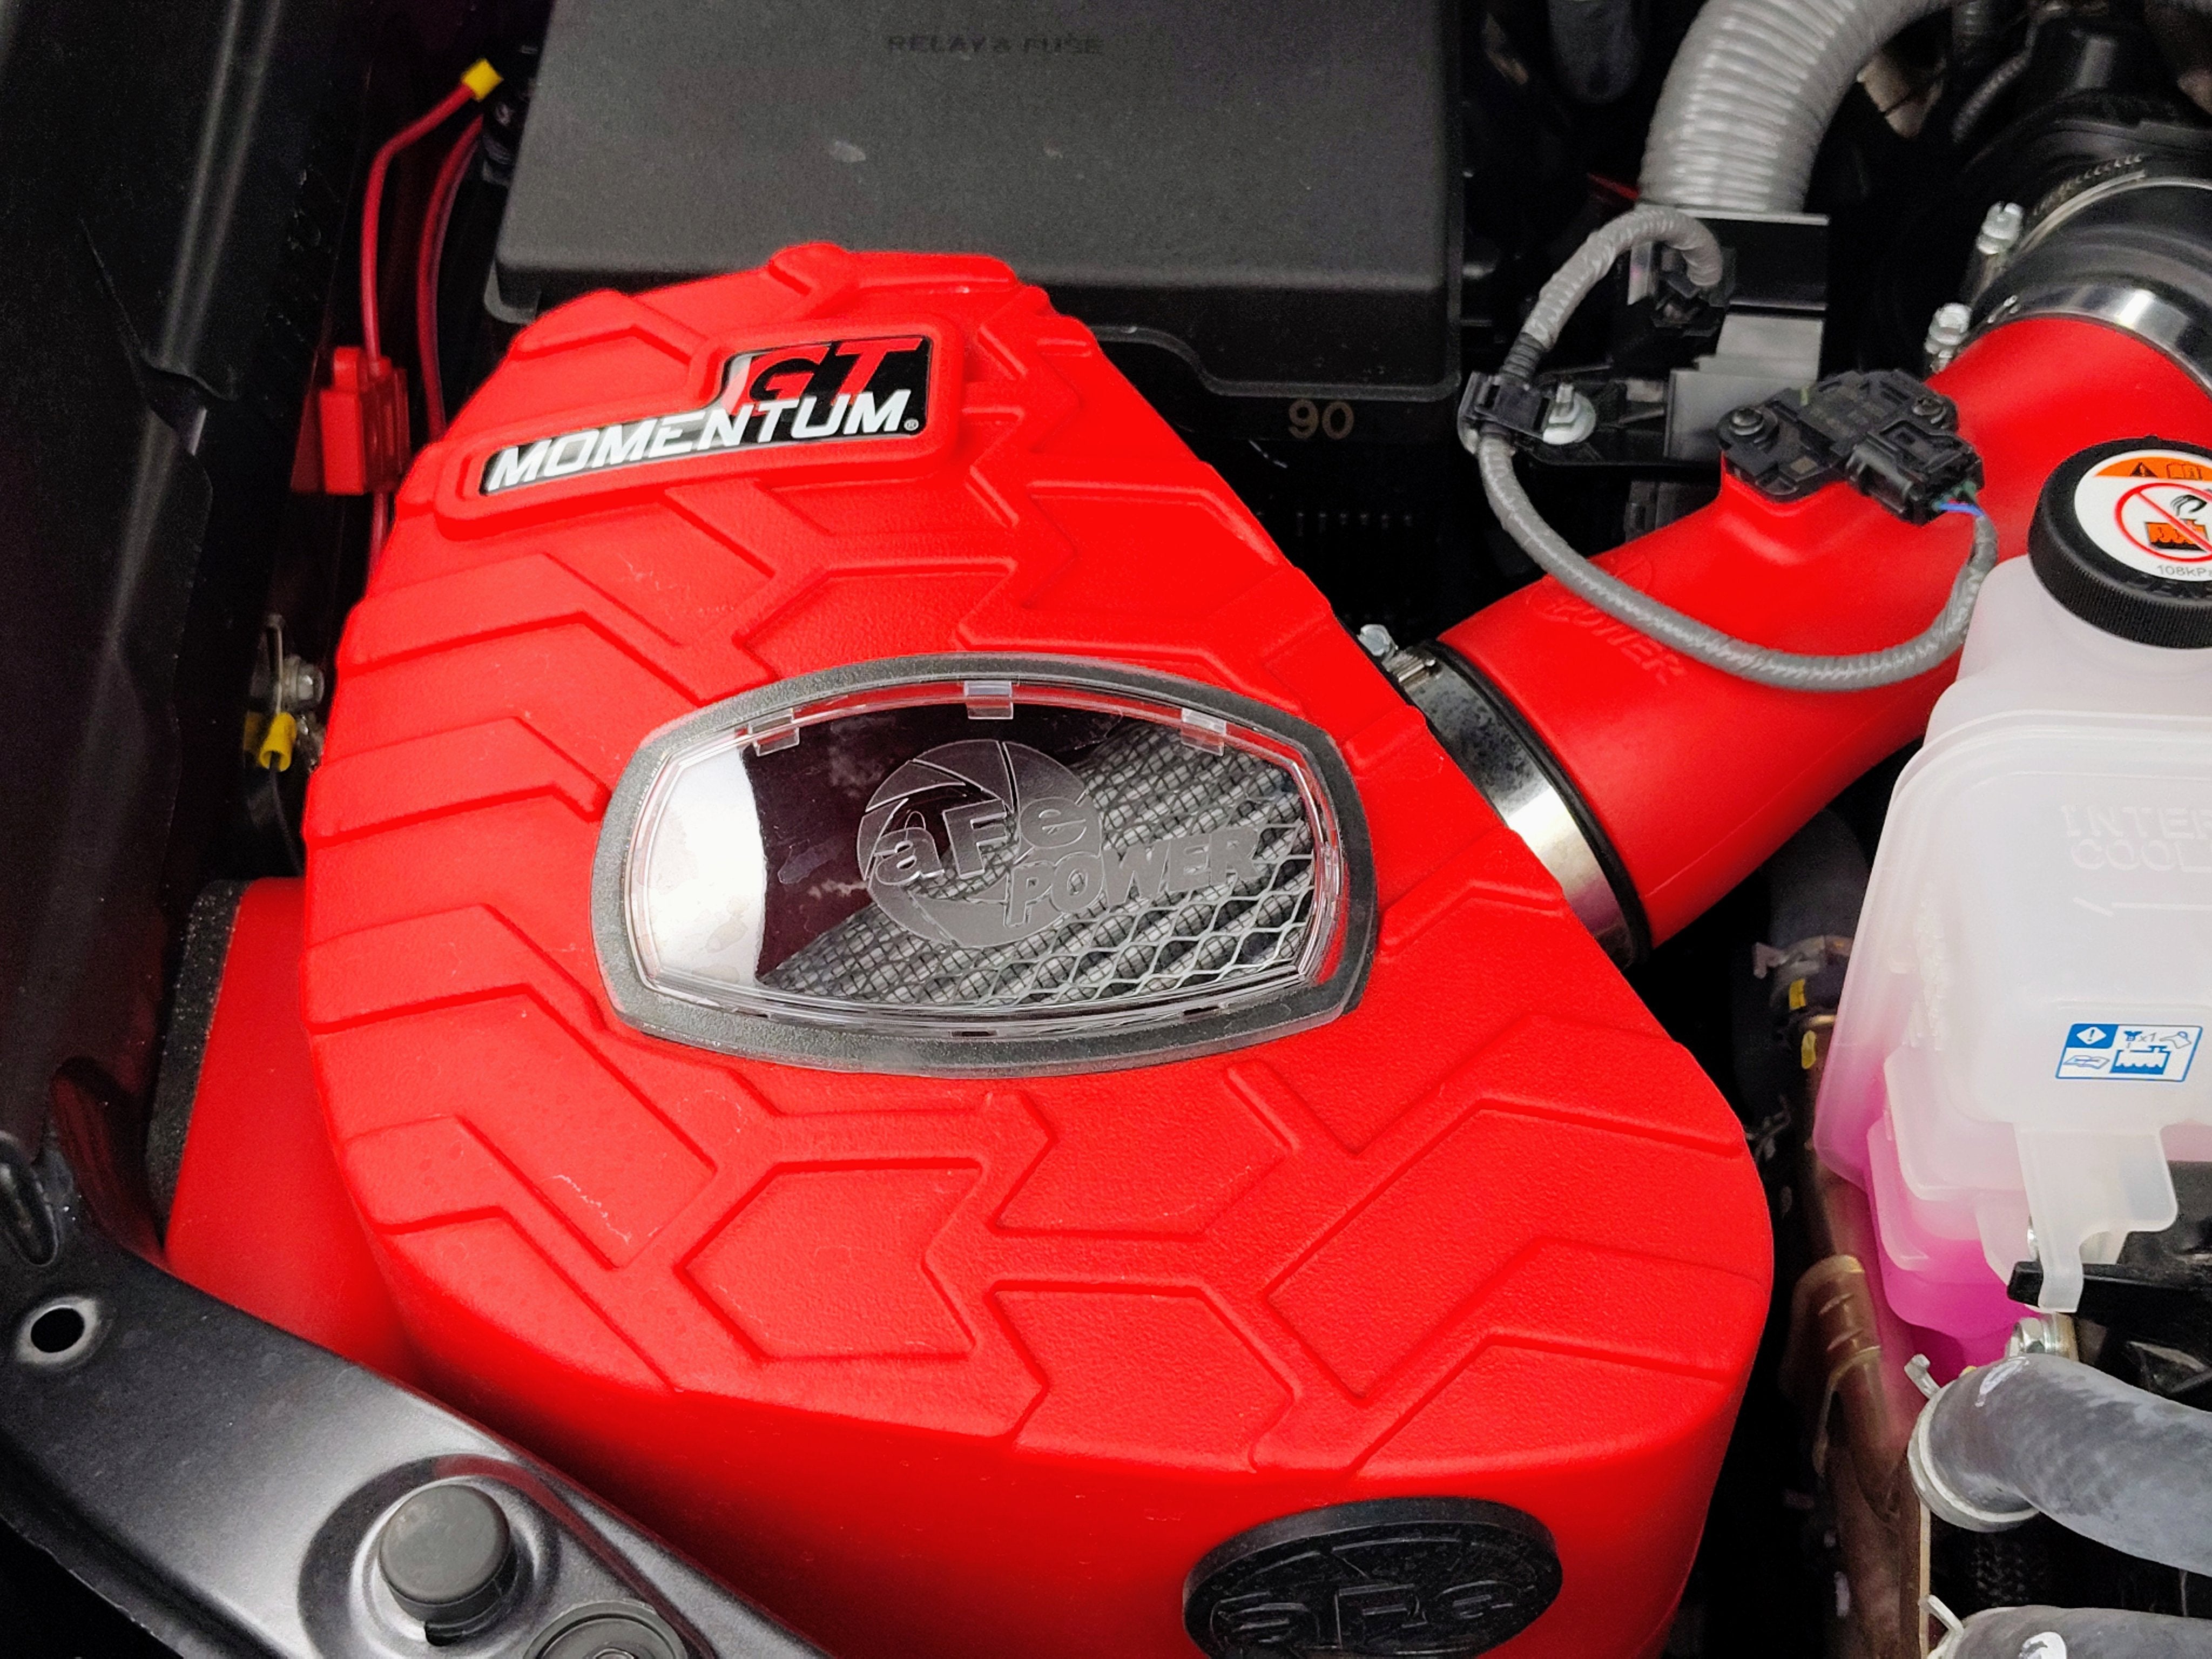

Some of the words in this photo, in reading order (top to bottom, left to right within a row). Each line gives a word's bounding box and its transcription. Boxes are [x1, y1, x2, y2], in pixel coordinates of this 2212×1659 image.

[887, 35, 986, 53] RELAY
[721, 336, 923, 417] GT
[1288, 399, 1354, 441] 90
[1003, 826, 1262, 929] POWER
